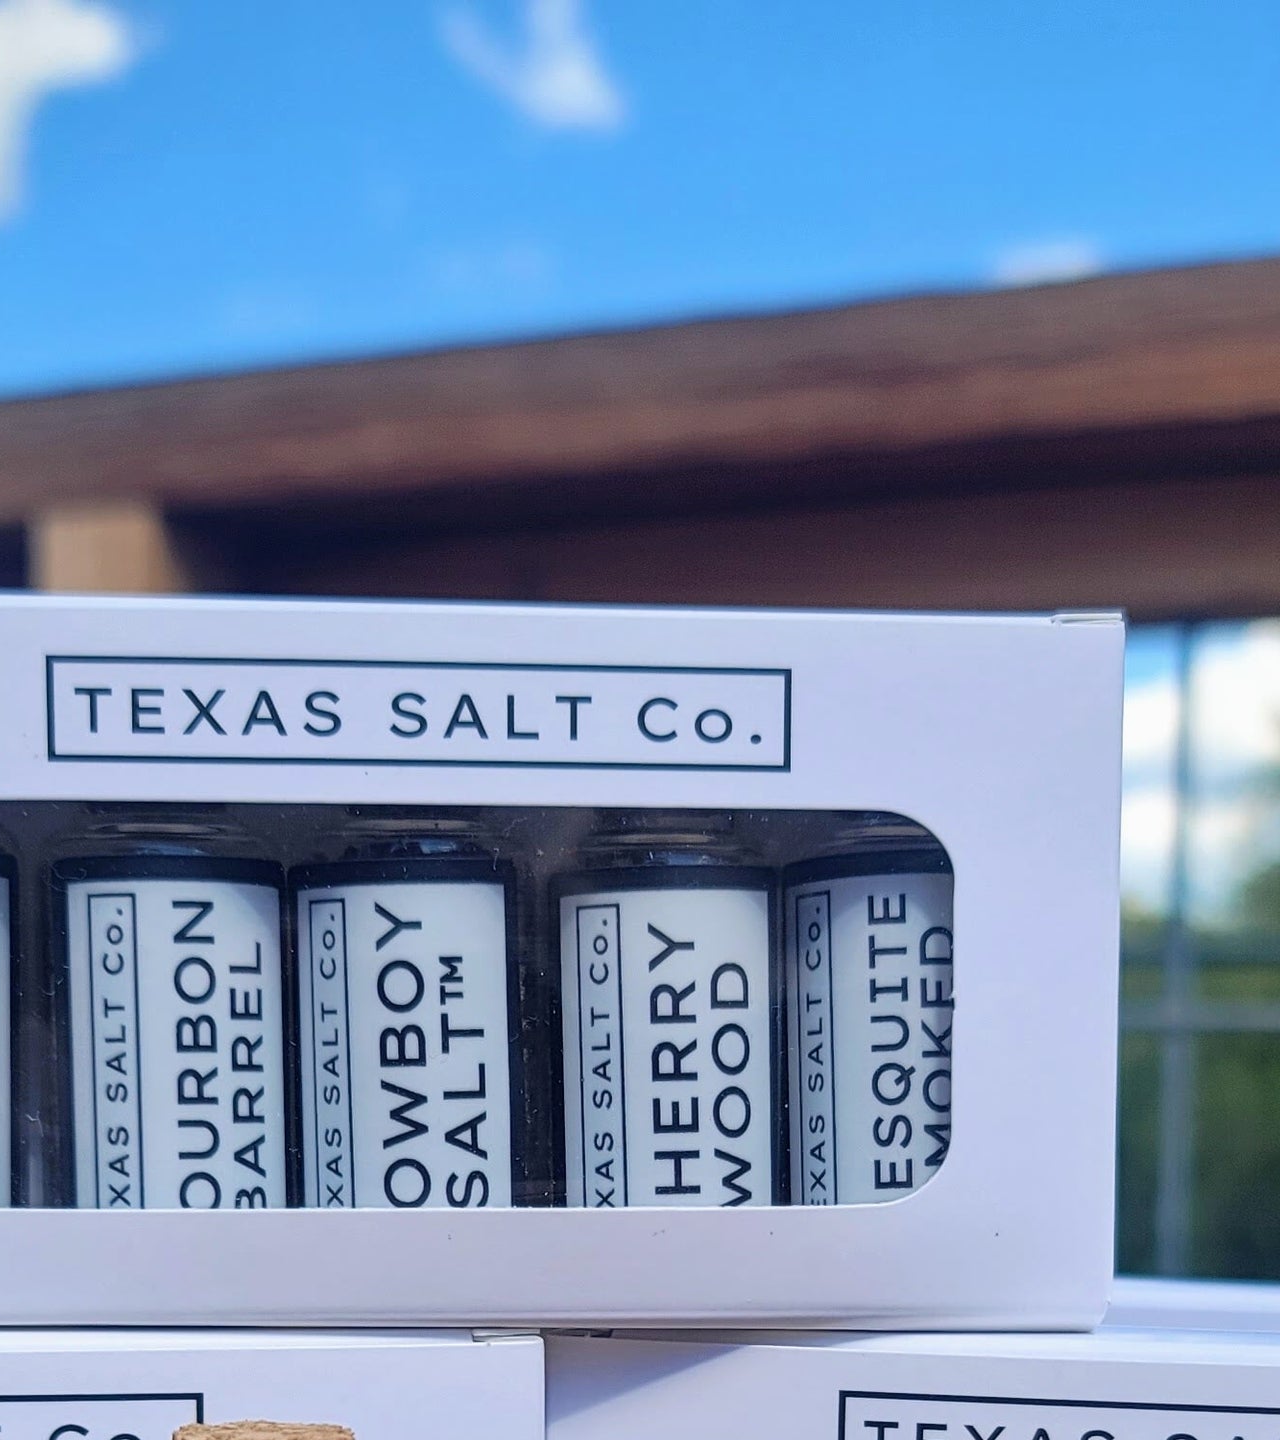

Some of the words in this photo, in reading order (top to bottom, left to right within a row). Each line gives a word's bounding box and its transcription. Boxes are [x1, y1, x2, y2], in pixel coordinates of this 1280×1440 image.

[74, 687, 343, 737] TEXAS
[389, 691, 593, 741] SALT
[636, 697, 763, 745] Co.
[102, 907, 125, 975] Co.
[319, 913, 336, 981] Co.
[589, 918, 610, 986] Co.
[103, 997, 129, 1104] SALT
[320, 1003, 341, 1106] SALT
[590, 1006, 614, 1109] SALT
[711, 962, 752, 1207] WOOD
[807, 993, 824, 1093] SALT
[868, 893, 915, 1190] ESQUITE
